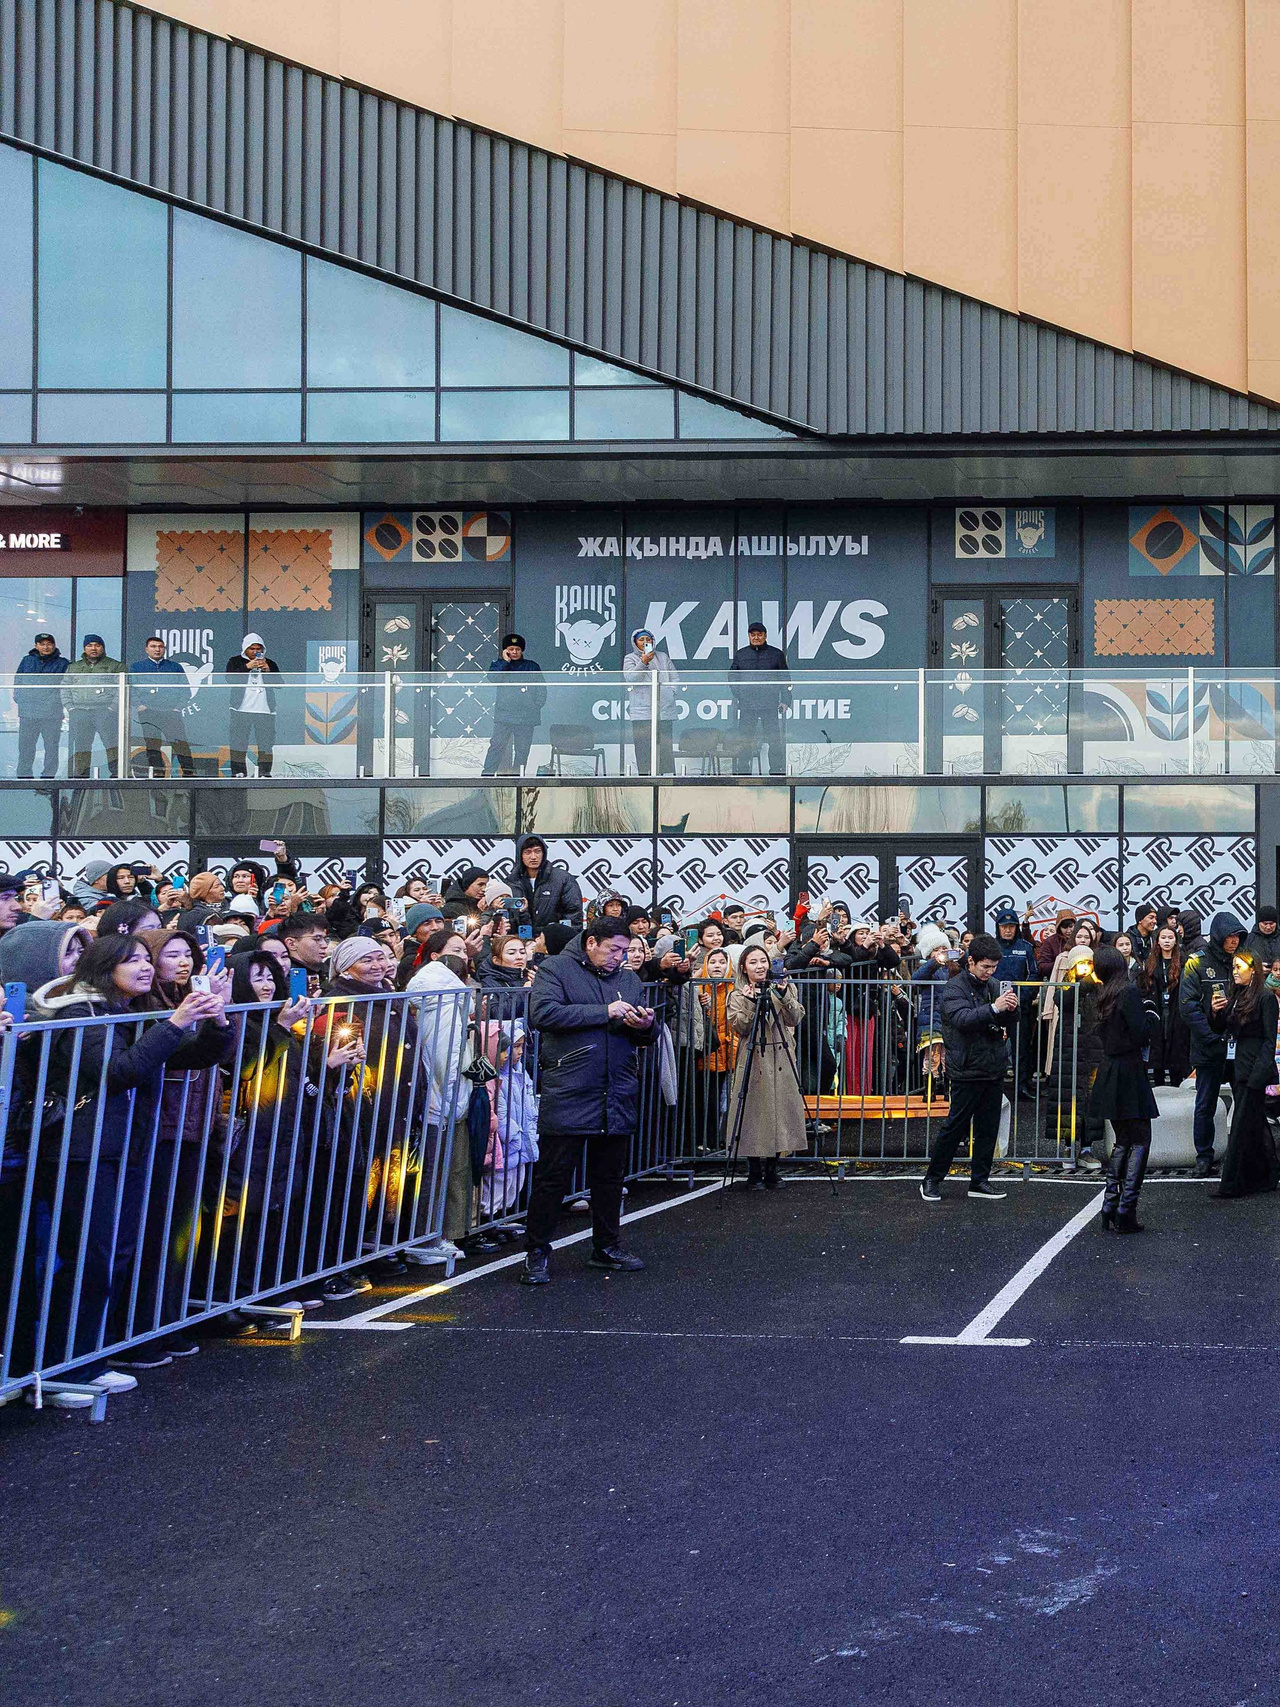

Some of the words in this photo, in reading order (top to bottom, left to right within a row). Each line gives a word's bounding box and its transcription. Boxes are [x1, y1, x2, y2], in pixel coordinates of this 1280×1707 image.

[9, 533, 61, 549] MORE
[577, 536, 723, 560] ЖАҚЫНДА
[729, 535, 869, 556] АШЫЛУЫ
[643, 599, 890, 660] KAWS
[561, 661, 604, 677] COFFEE
[592, 700, 690, 720] СКО
[696, 699, 851, 720] ОТЫТИЕ
